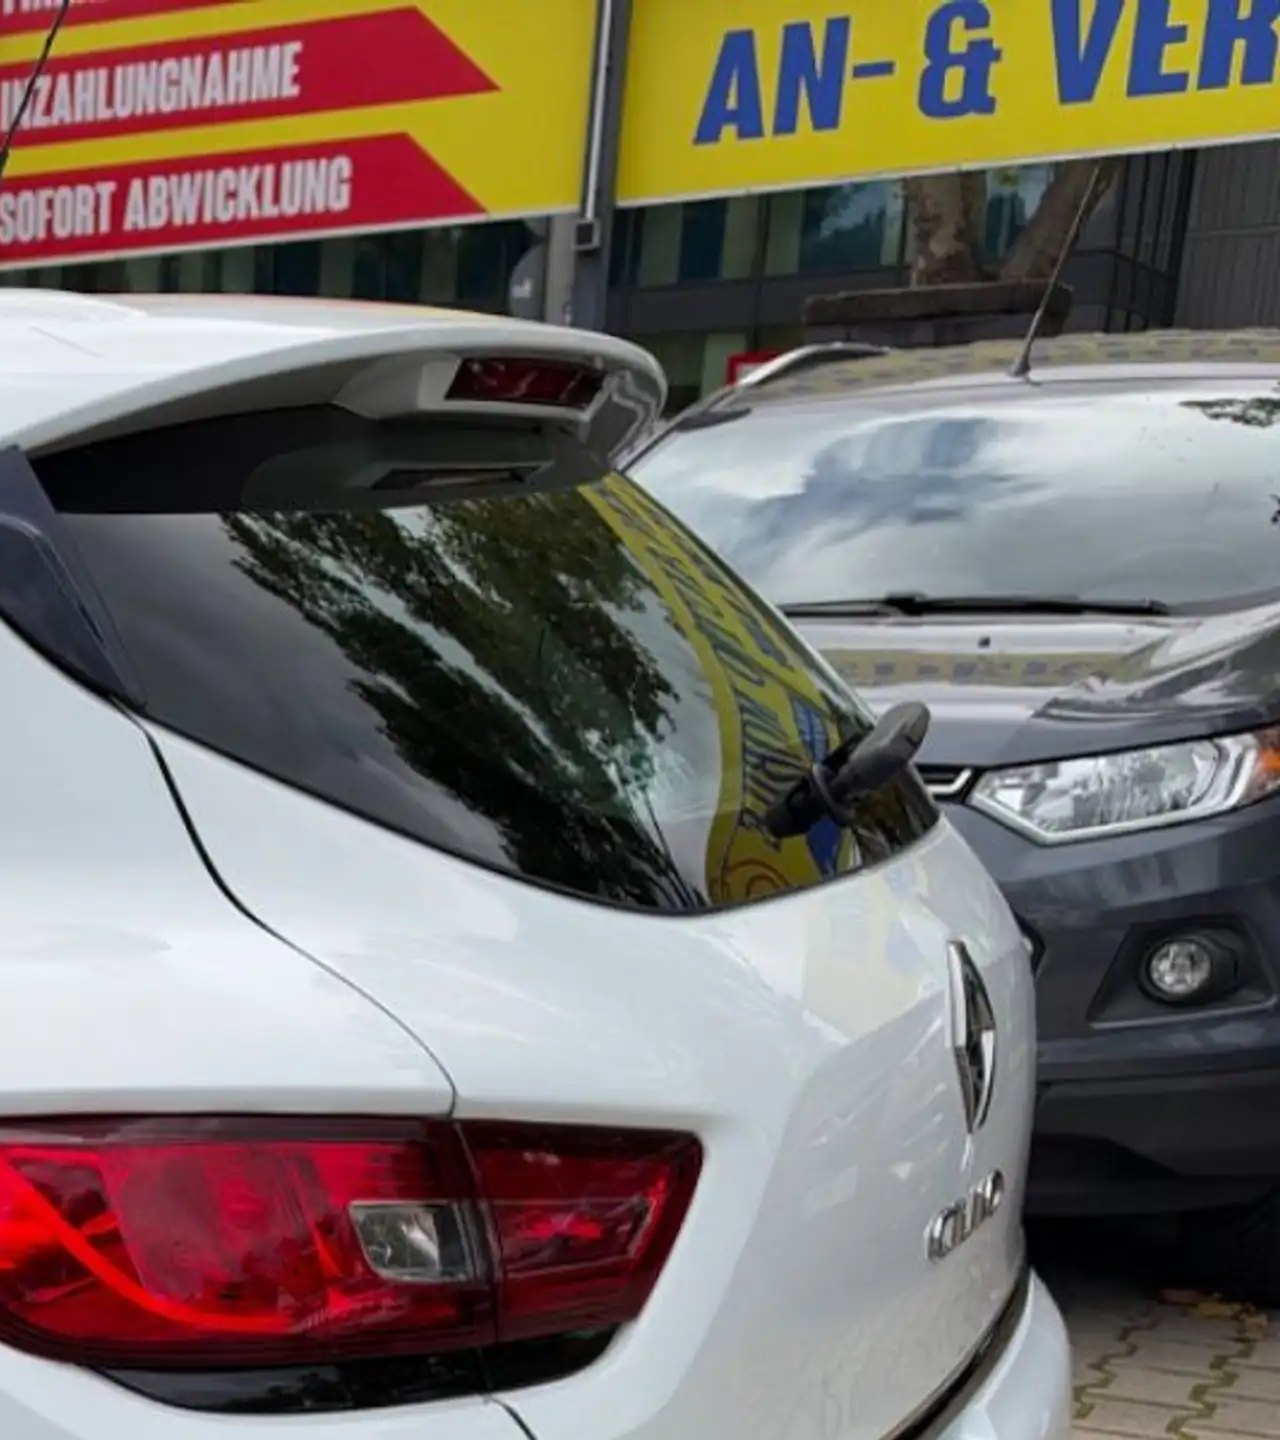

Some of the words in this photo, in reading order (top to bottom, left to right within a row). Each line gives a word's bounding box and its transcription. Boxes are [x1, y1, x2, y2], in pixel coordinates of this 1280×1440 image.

[0, 41, 303, 133] INZAHLUNGNAHME
[692, 16, 896, 146] AN-
[916, 0, 1002, 118] &
[123, 154, 353, 232] ABWICKLUNG
